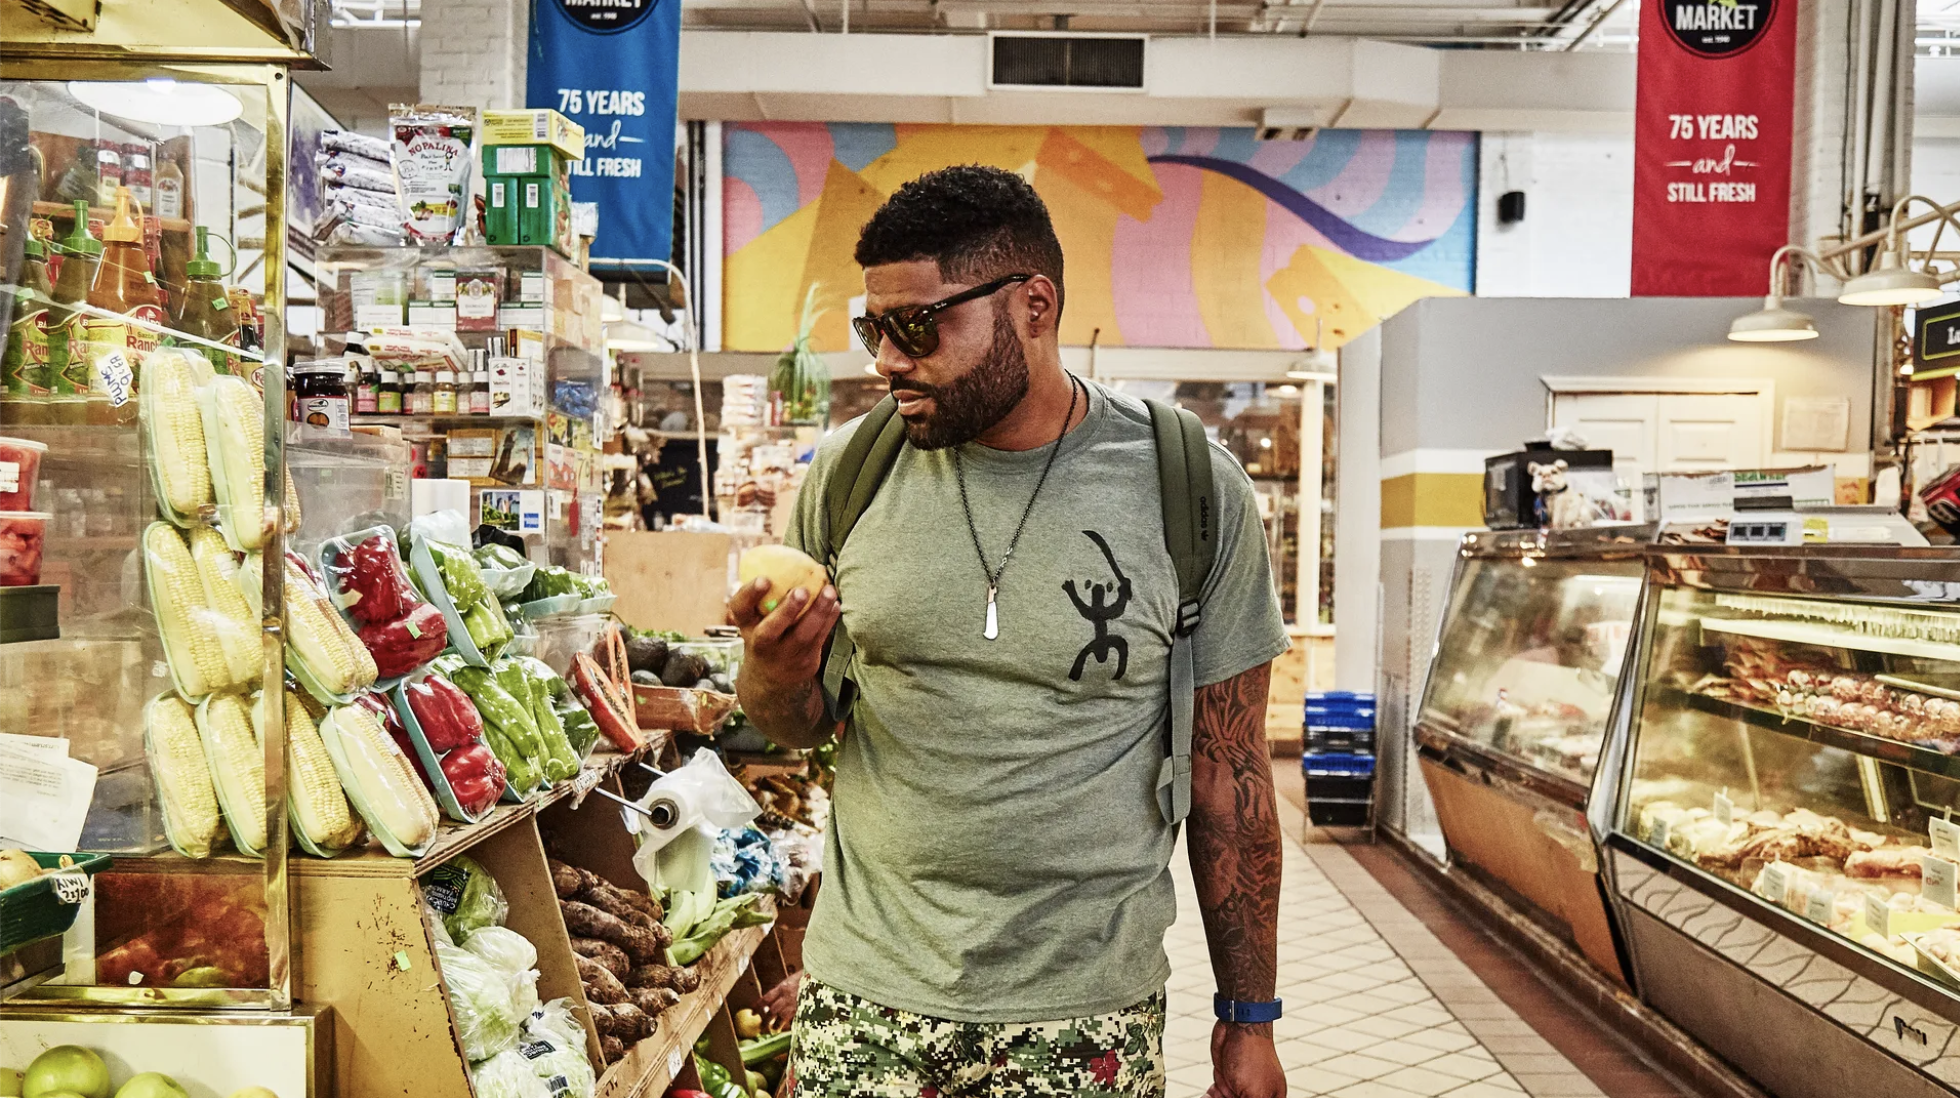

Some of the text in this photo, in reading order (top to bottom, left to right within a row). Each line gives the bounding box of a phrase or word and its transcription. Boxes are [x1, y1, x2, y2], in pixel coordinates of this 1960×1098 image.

[1675, 4, 1758, 30] MARKET
[558, 88, 645, 116] 75 YEARS
[584, 119, 622, 150] and
[1668, 114, 1759, 139] 75 YEARS
[408, 141, 458, 157] NOPALINA
[1692, 143, 1735, 176] and
[567, 157, 642, 178] TILL FRESH
[1667, 182, 1756, 202] STILL FRESH
[101, 365, 128, 405] PLUMS
[1200, 496, 1209, 528] adidas
[55, 877, 83, 891] KIWI
